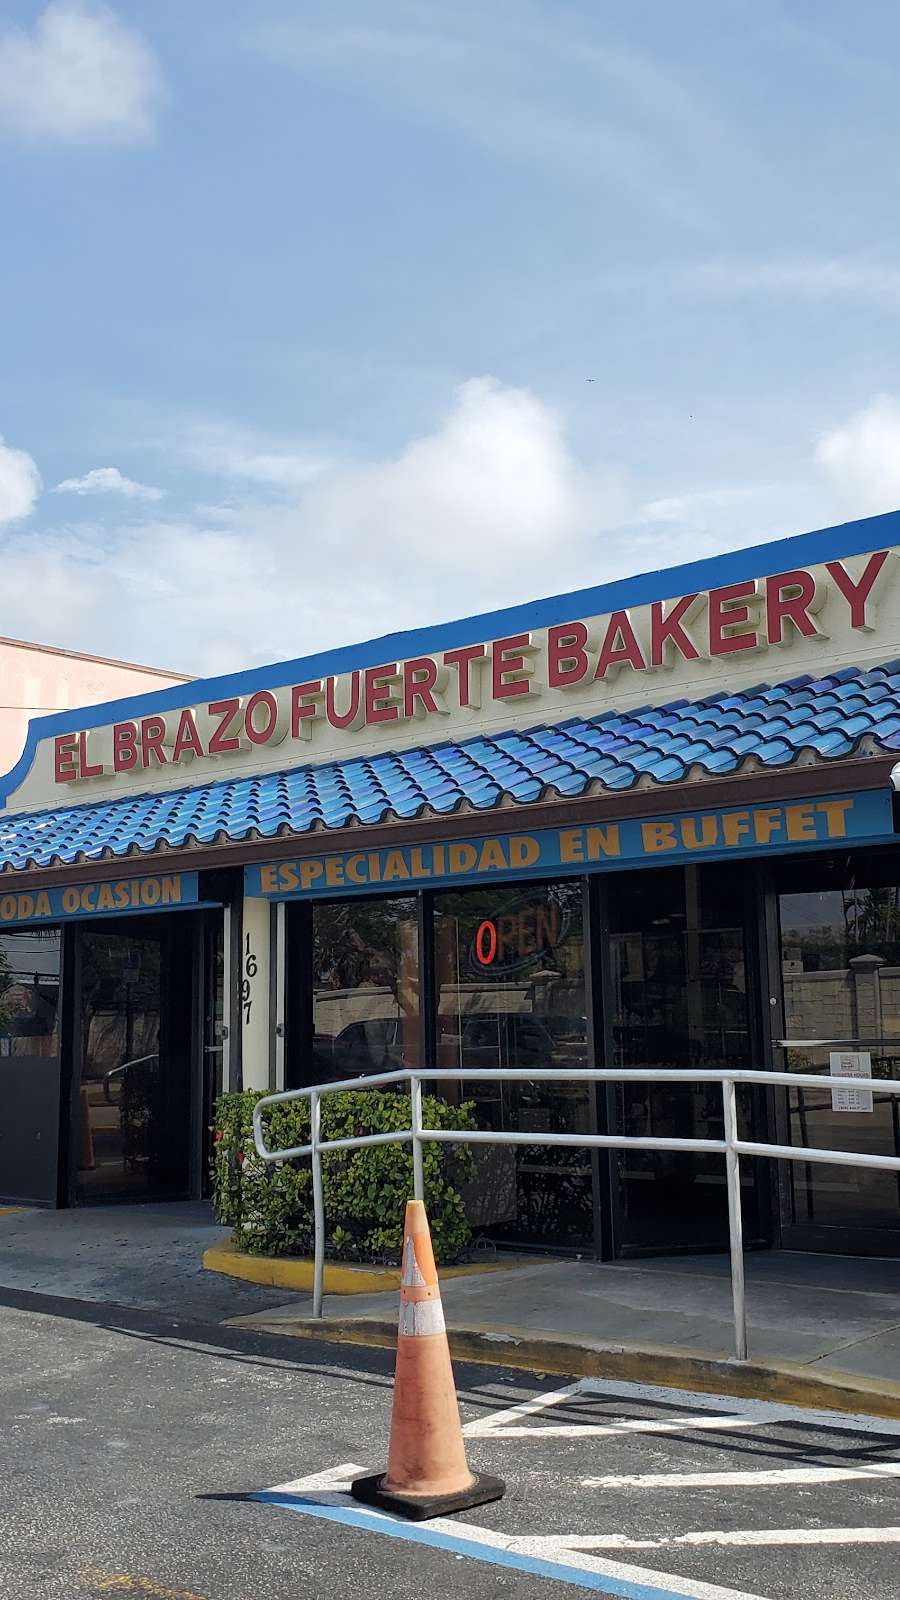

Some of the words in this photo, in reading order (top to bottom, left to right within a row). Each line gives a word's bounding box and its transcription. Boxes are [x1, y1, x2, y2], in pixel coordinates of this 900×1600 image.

[54, 731, 104, 783] EL
[113, 690, 279, 773] BRAZO
[291, 634, 531, 738] FUERTE
[547, 550, 891, 689] BAKERY
[260, 836, 541, 893] ESPECIALIDAD
[559, 824, 621, 863] EN
[641, 800, 854, 852] BUFFET
[63, 876, 182, 913] OCASION
[476, 904, 558, 965] OPEN
[241, 932, 257, 1024] 1697
